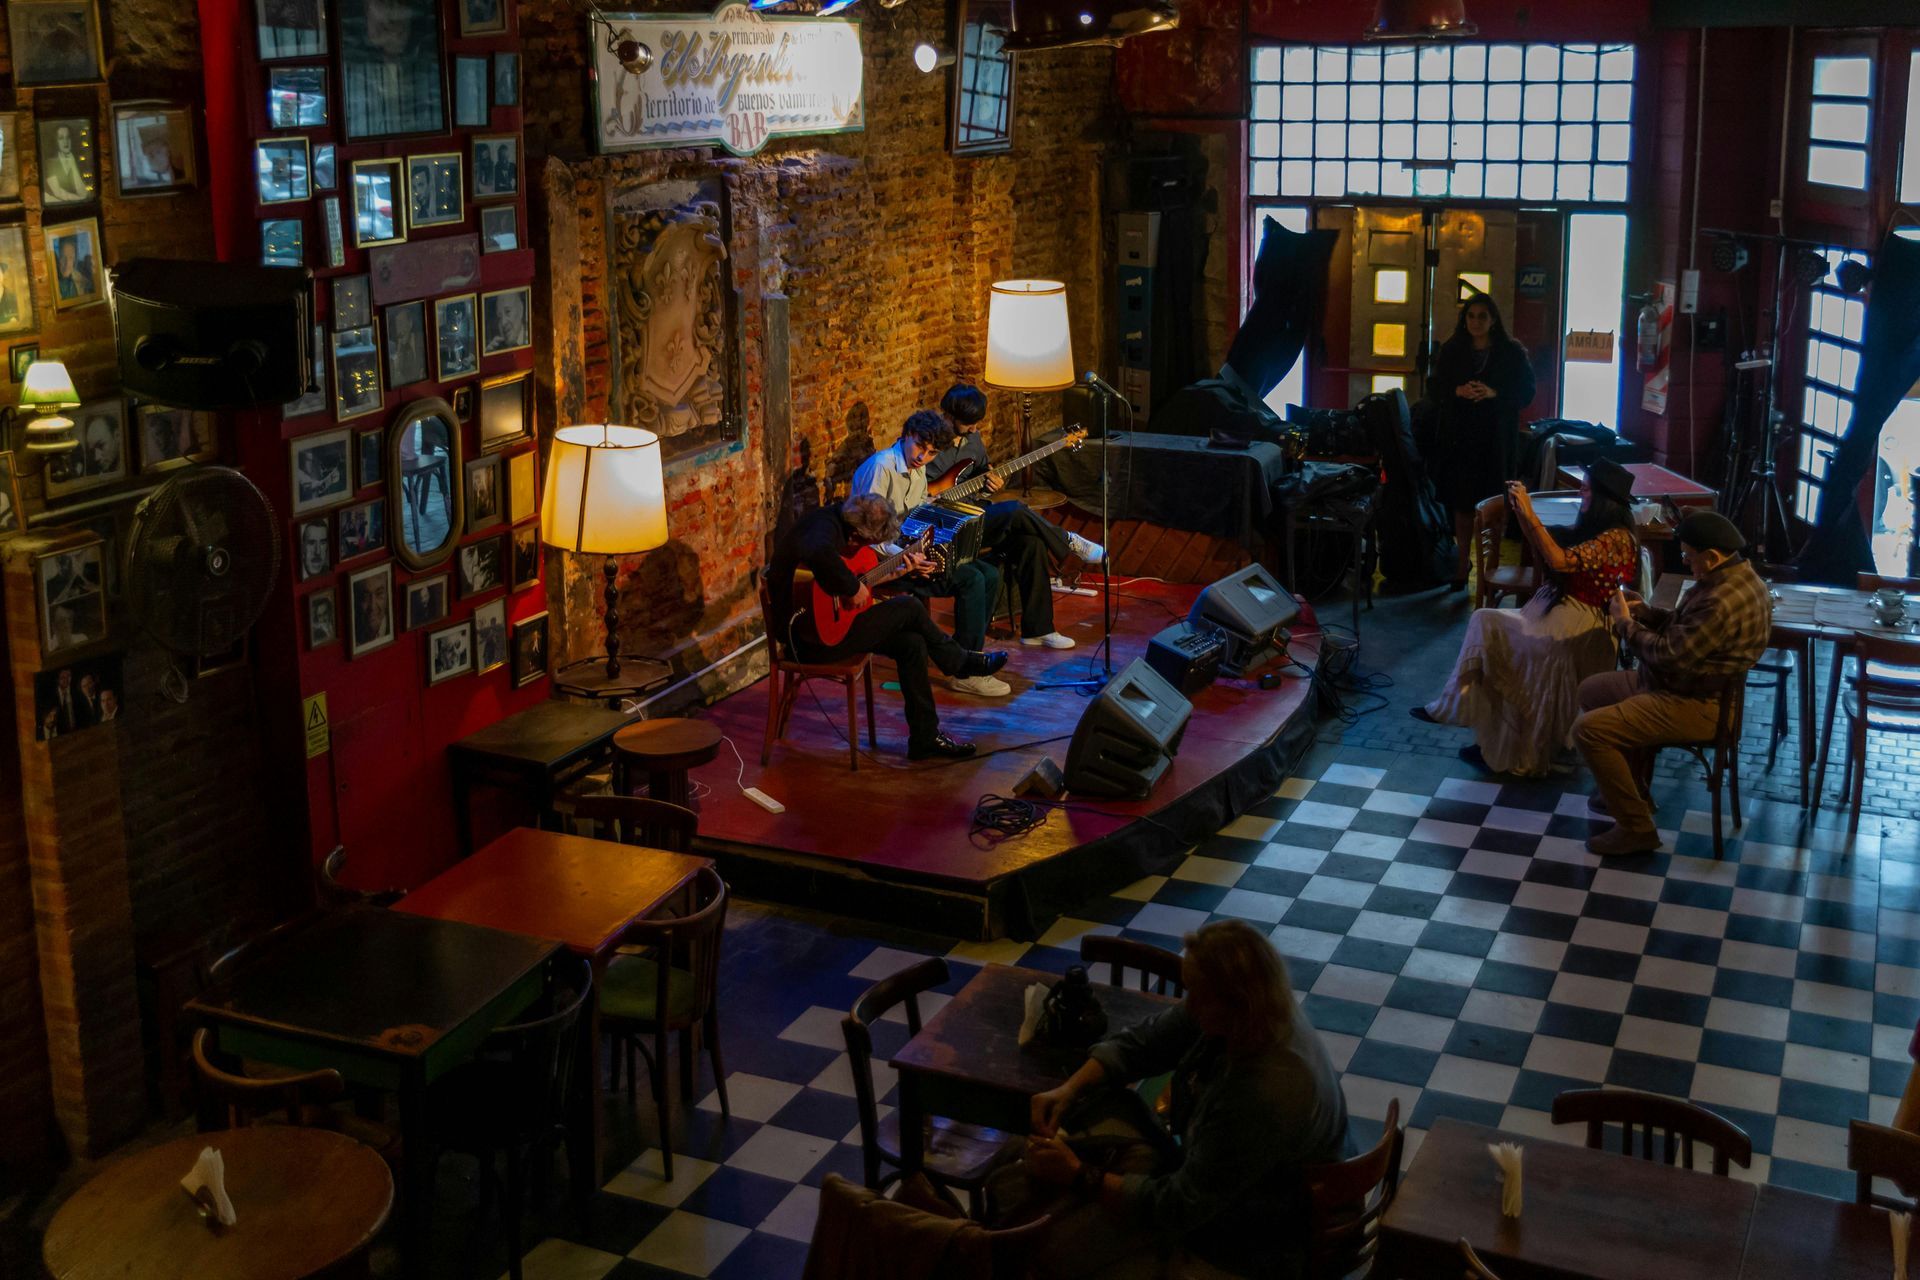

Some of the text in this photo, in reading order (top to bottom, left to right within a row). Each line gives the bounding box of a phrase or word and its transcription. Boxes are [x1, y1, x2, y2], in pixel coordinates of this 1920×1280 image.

[660, 30, 700, 82] El
[726, 112, 773, 150] BAR
[1520, 273, 1547, 286] ADT
